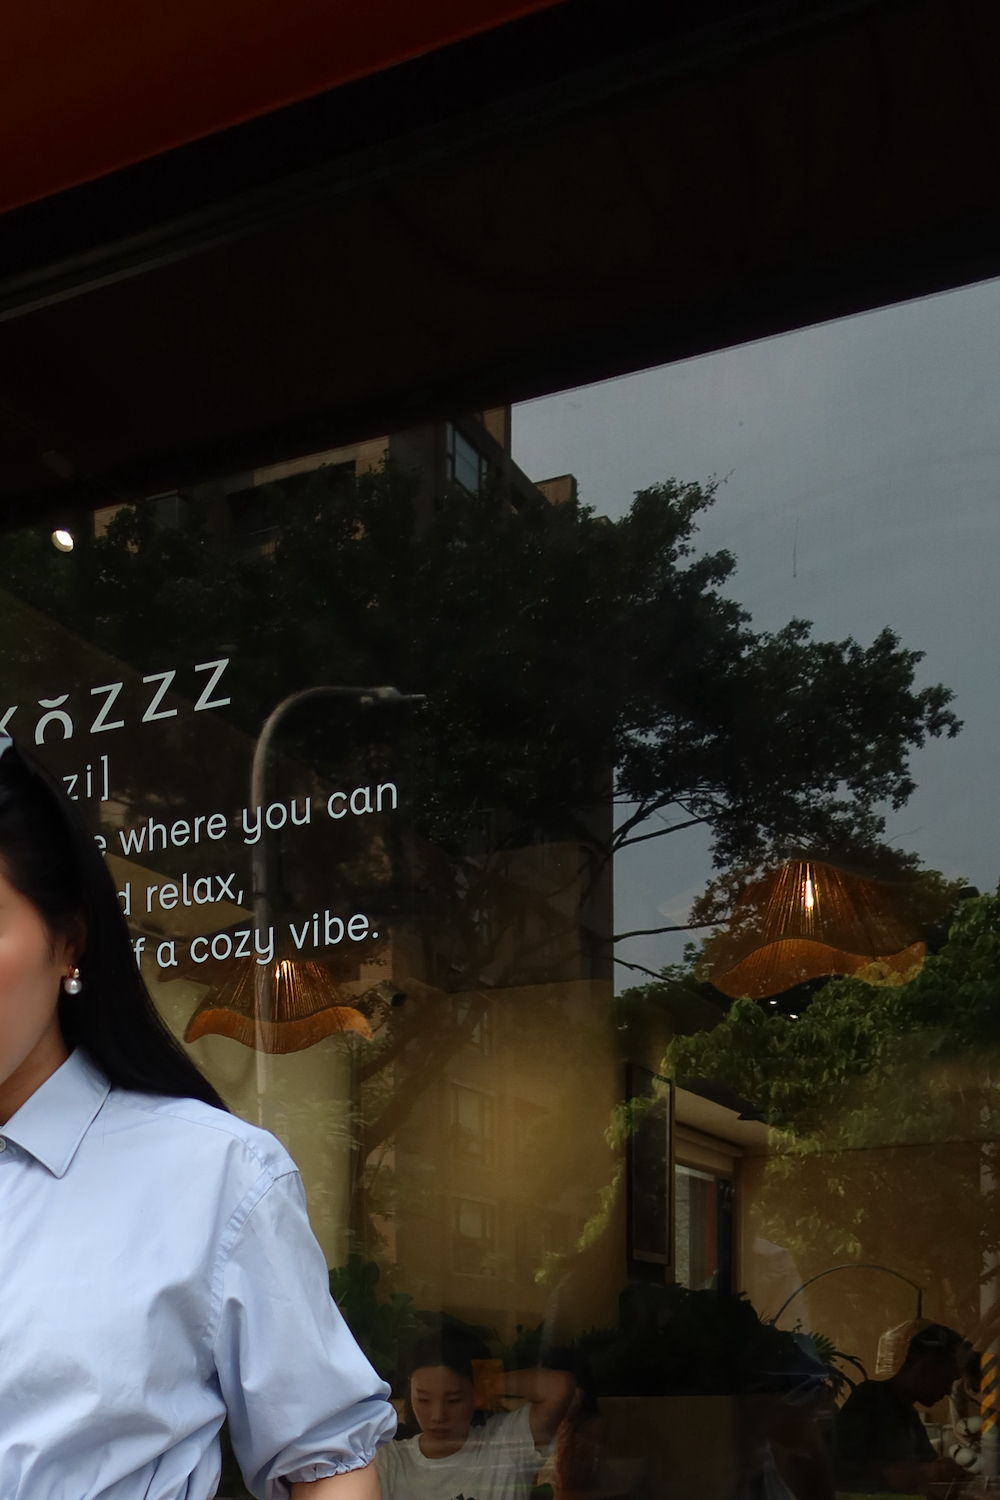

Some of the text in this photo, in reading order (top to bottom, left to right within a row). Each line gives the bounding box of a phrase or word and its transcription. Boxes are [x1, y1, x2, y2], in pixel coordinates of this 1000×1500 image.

[118, 812, 228, 857] where
[241, 796, 312, 845] you
[326, 781, 398, 820] can
[145, 871, 245, 914] relax,
[156, 940, 179, 969] a
[189, 925, 275, 966] cozy
[288, 908, 380, 949] vibe.
